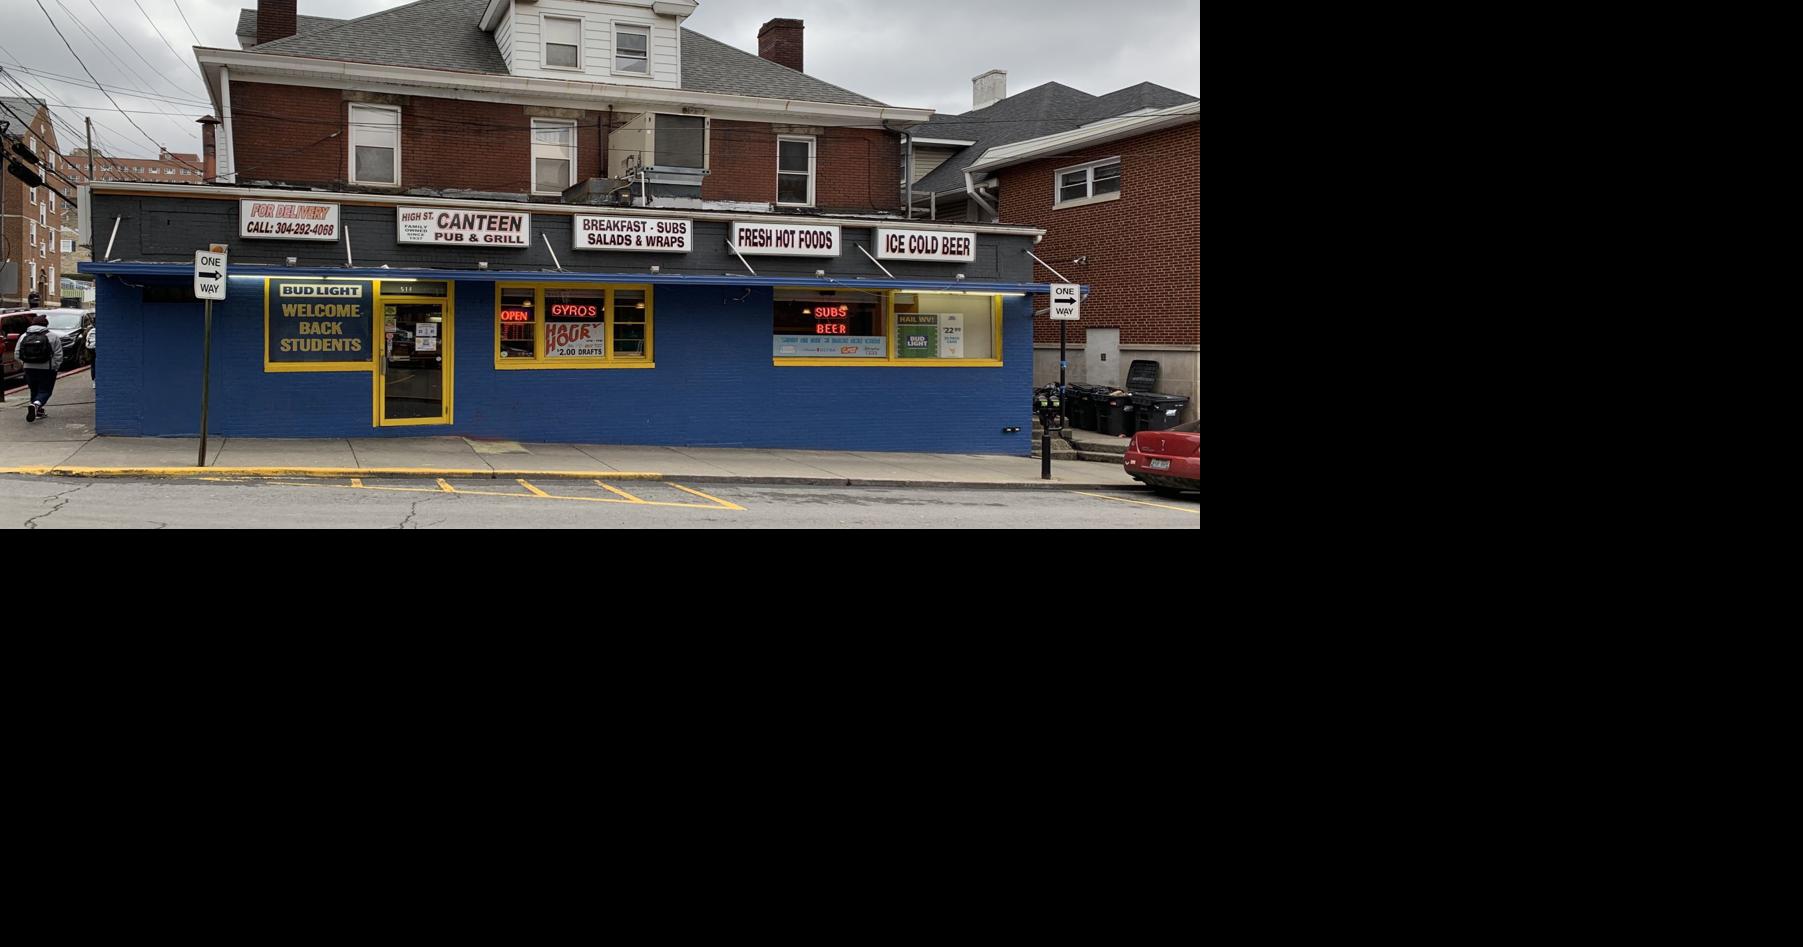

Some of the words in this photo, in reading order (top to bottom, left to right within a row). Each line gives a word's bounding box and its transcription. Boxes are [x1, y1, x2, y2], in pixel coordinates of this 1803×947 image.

[251, 203, 275, 218] FOR
[275, 204, 330, 220] DELIVERY
[402, 212, 421, 221] HIGH
[423, 211, 434, 220] ST.
[247, 221, 274, 233] CALL:
[275, 222, 334, 235] 304-292-4068
[437, 213, 522, 232] CANTEEN
[583, 219, 647, 233] BREAKFAST
[657, 222, 687, 234] SUBS
[434, 232, 464, 242] PUB
[468, 233, 479, 243] &
[483, 234, 525, 244] GRILL
[588, 233, 632, 246] SALADS
[635, 235, 642, 247] &
[646, 235, 685, 248] WRAPS
[738, 228, 772, 247] FRESH
[775, 229, 796, 248] HOT
[798, 230, 833, 249] FOODS
[886, 233, 905, 254] ICE
[908, 234, 939, 254] COLD
[942, 236, 970, 256] BEER
[200, 256, 221, 267] ONE
[200, 283, 219, 293] WAY
[283, 286, 315, 295] BUD
[316, 287, 359, 296] LIGHT
[1055, 287, 1075, 295] ONE
[281, 303, 361, 317] WELCOME
[500, 310, 528, 321] OPEN
[552, 304, 597, 317] GYROS
[815, 307, 847, 318] SUBS
[1055, 307, 1074, 315] WAY
[299, 321, 343, 335] BACK
[816, 323, 846, 334] BEER
[280, 338, 362, 352] STUDENTS
[546, 328, 591, 356] HOUR
